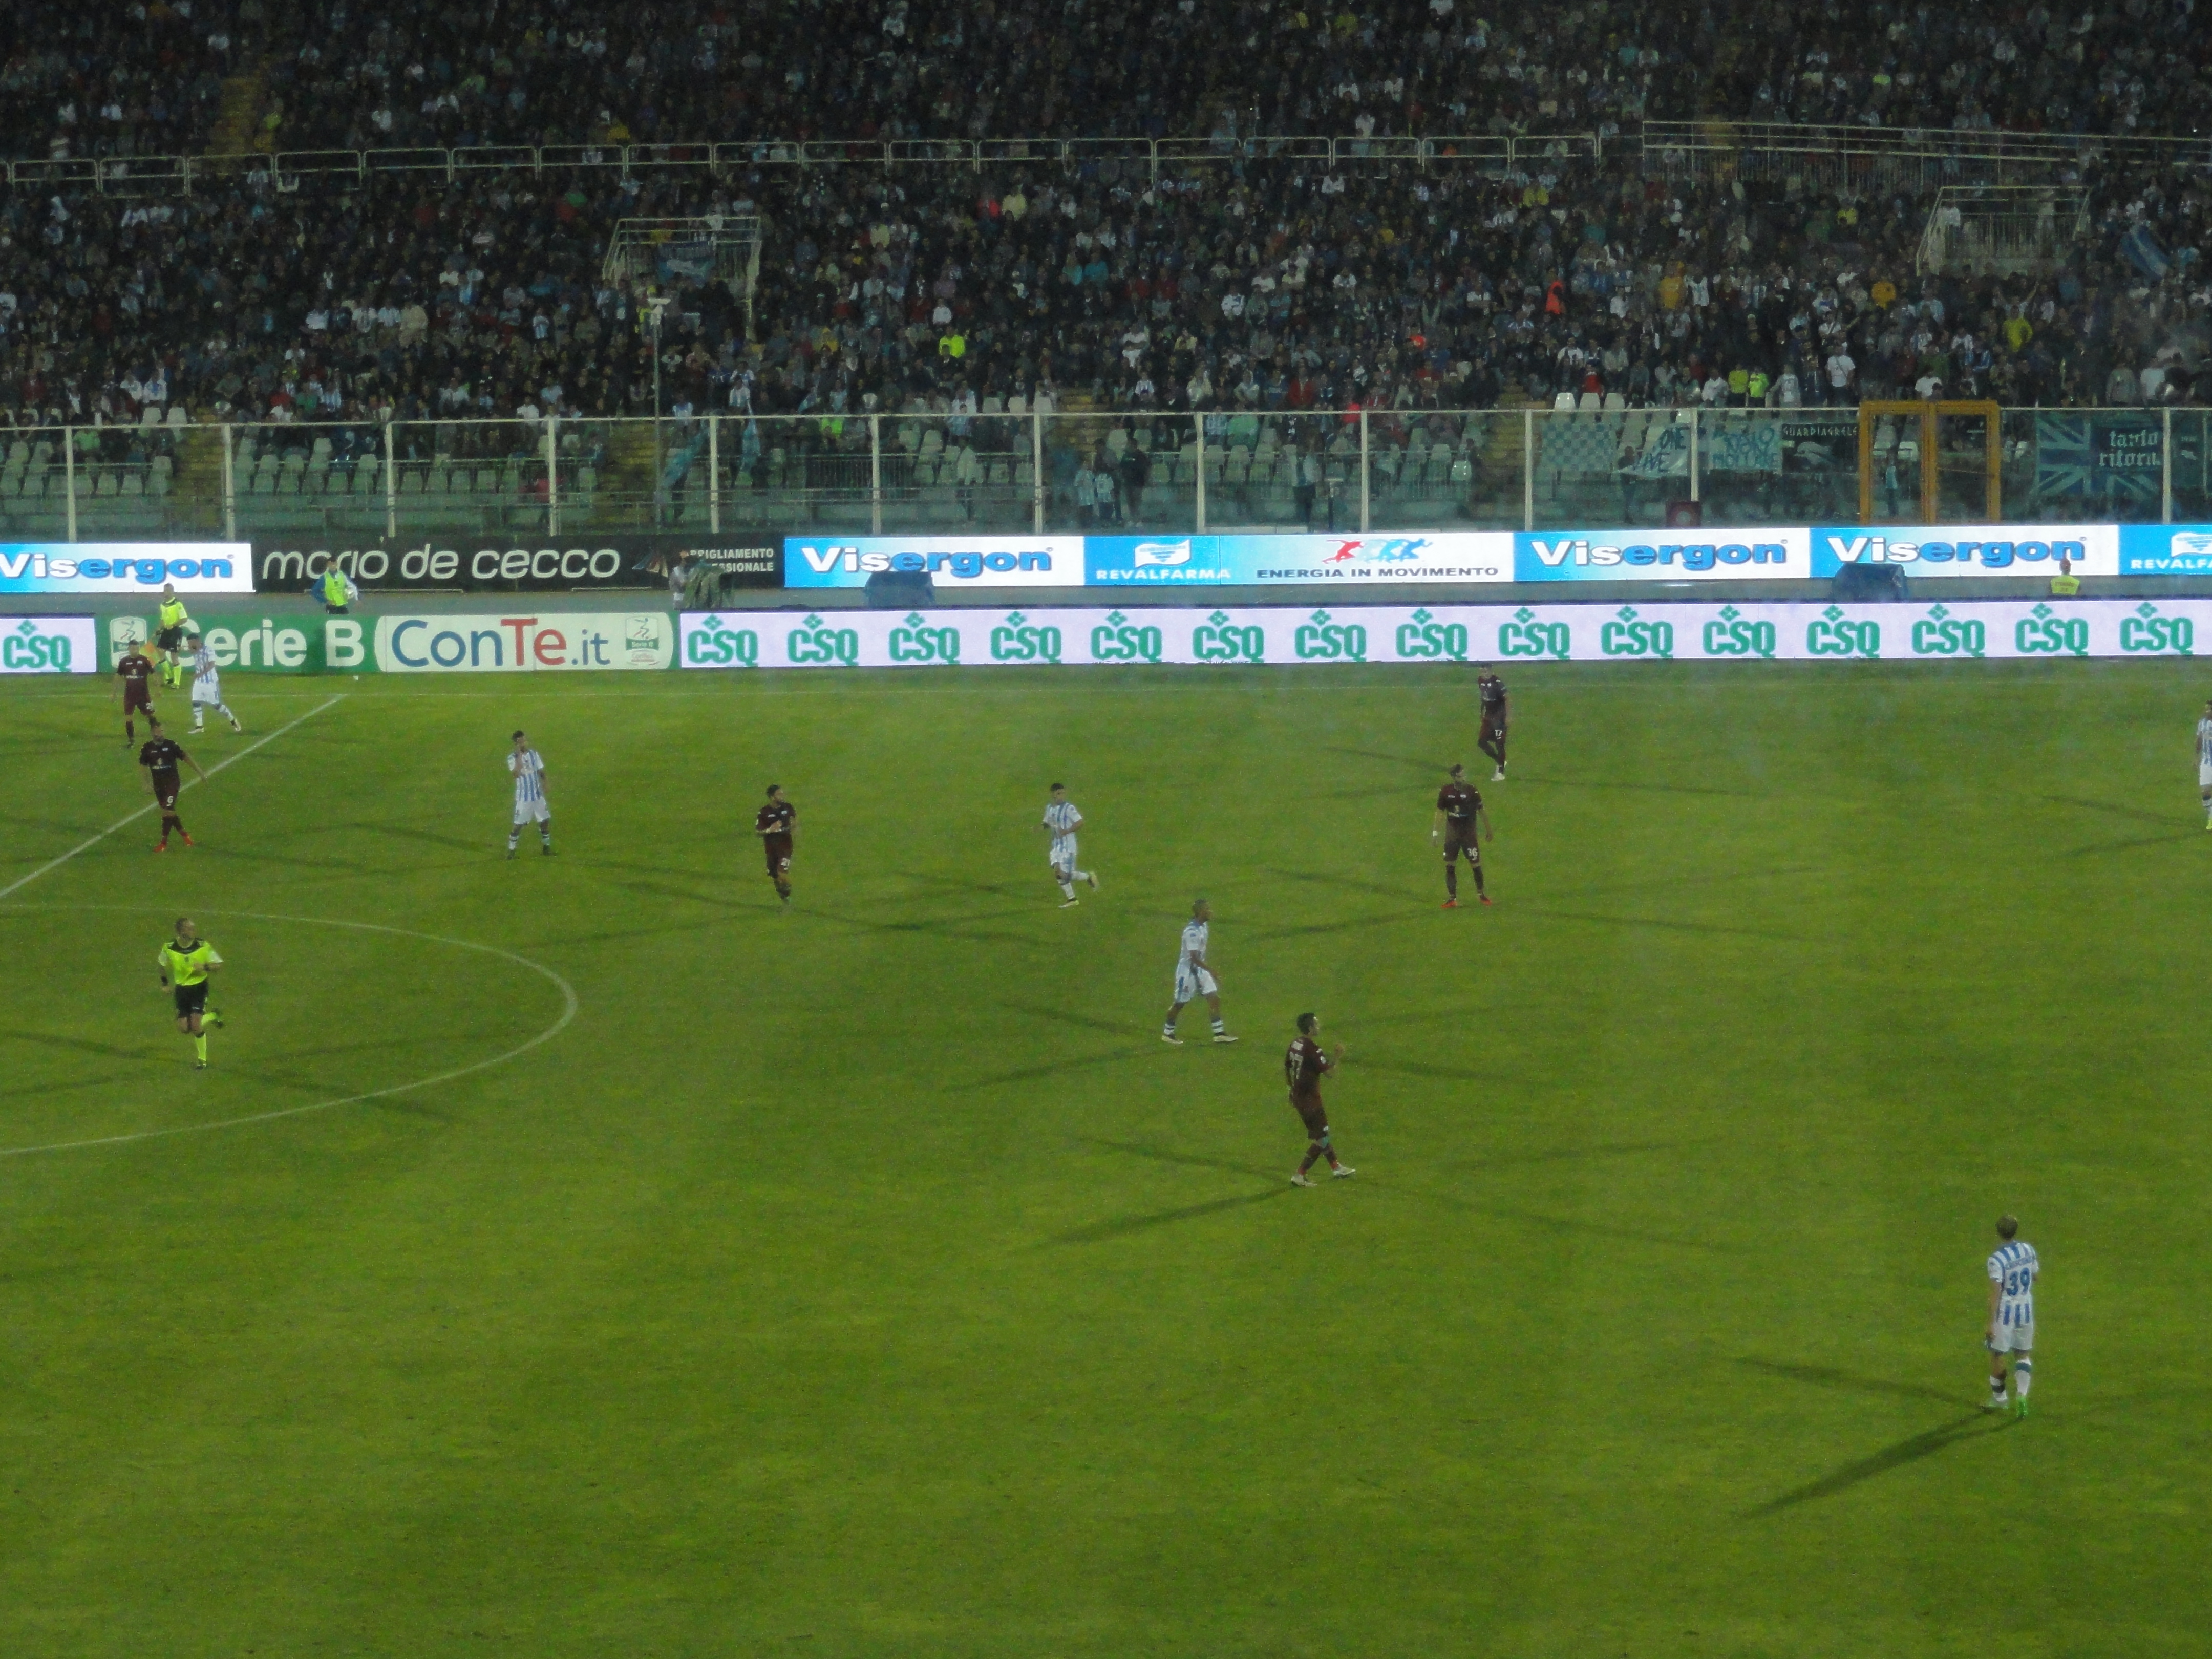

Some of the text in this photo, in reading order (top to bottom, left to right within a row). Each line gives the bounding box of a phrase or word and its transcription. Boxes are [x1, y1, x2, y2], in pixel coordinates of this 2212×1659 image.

[0, 553, 233, 583] Visergon
[401, 544, 457, 579] de
[472, 549, 620, 579] cecco
[802, 547, 1052, 577] Visergon
[1532, 540, 1787, 570] Visergon
[1827, 537, 2086, 567] Visergon
[1096, 569, 1231, 580] REVALFARMA
[1257, 567, 1499, 578] ENERGIA IN MOVIMENTO
[3, 636, 71, 671] CSQ
[326, 620, 364, 666] B
[391, 618, 610, 666] ConTe.it
[688, 630, 758, 667] CSQ
[788, 629, 859, 666] CSQ
[889, 627, 960, 665] CSQ
[991, 626, 1062, 664] CSQ
[1091, 626, 1162, 663] CSQ
[1193, 626, 1264, 663] CSQ
[1295, 625, 1367, 662] CSQ
[1396, 624, 1468, 661] CSQ
[1499, 623, 1570, 660] CSQ
[1601, 622, 1673, 659] CSQ
[1703, 621, 1776, 658] CSQ
[1807, 621, 1881, 659] CSQ
[1912, 620, 1986, 657] CSQ
[2015, 619, 2089, 656] CSQ
[2120, 618, 2194, 655] CSQ
[2007, 1267, 2030, 1296] 39
